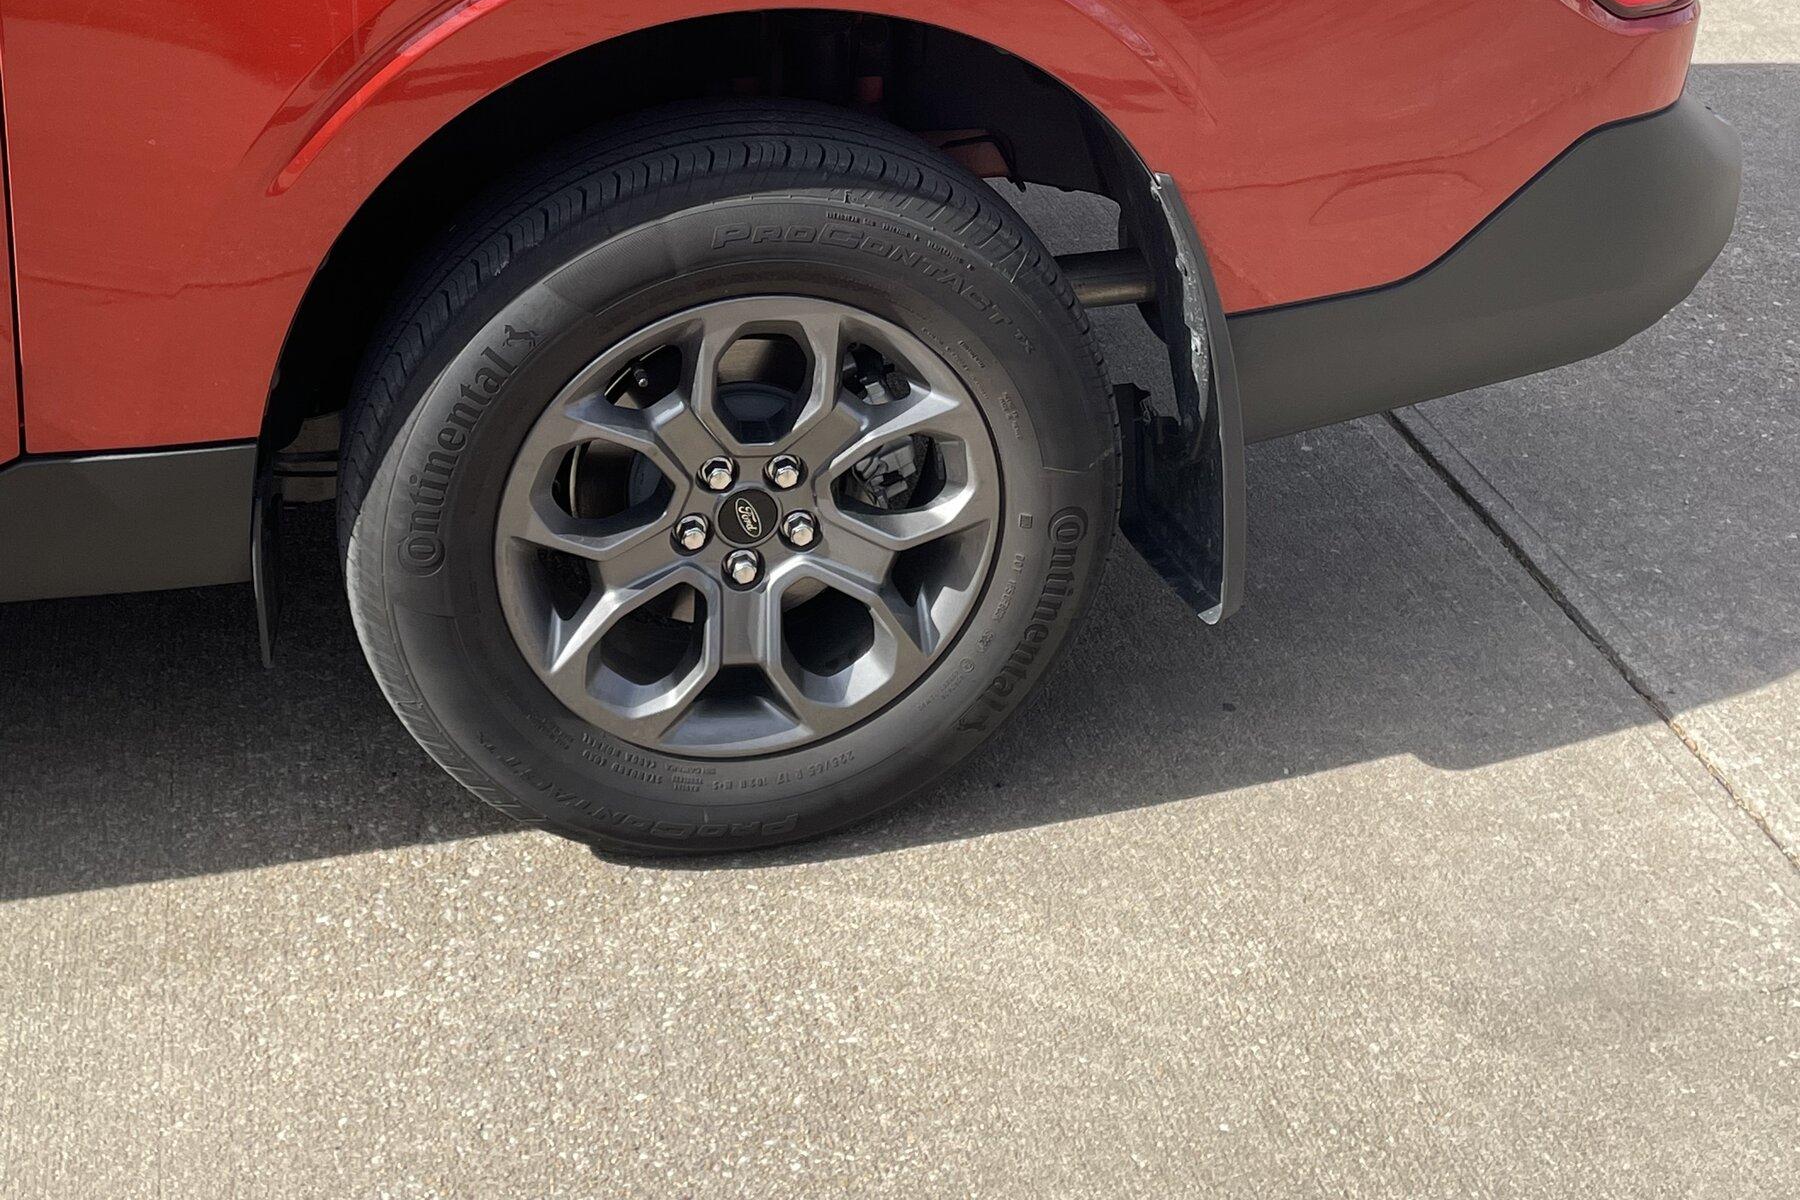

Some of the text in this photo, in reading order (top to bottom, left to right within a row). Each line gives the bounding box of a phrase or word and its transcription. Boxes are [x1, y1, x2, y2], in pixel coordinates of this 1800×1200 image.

[397, 346, 518, 577] Continental
[737, 505, 759, 532] Ford
[979, 506, 1089, 712] Continental
